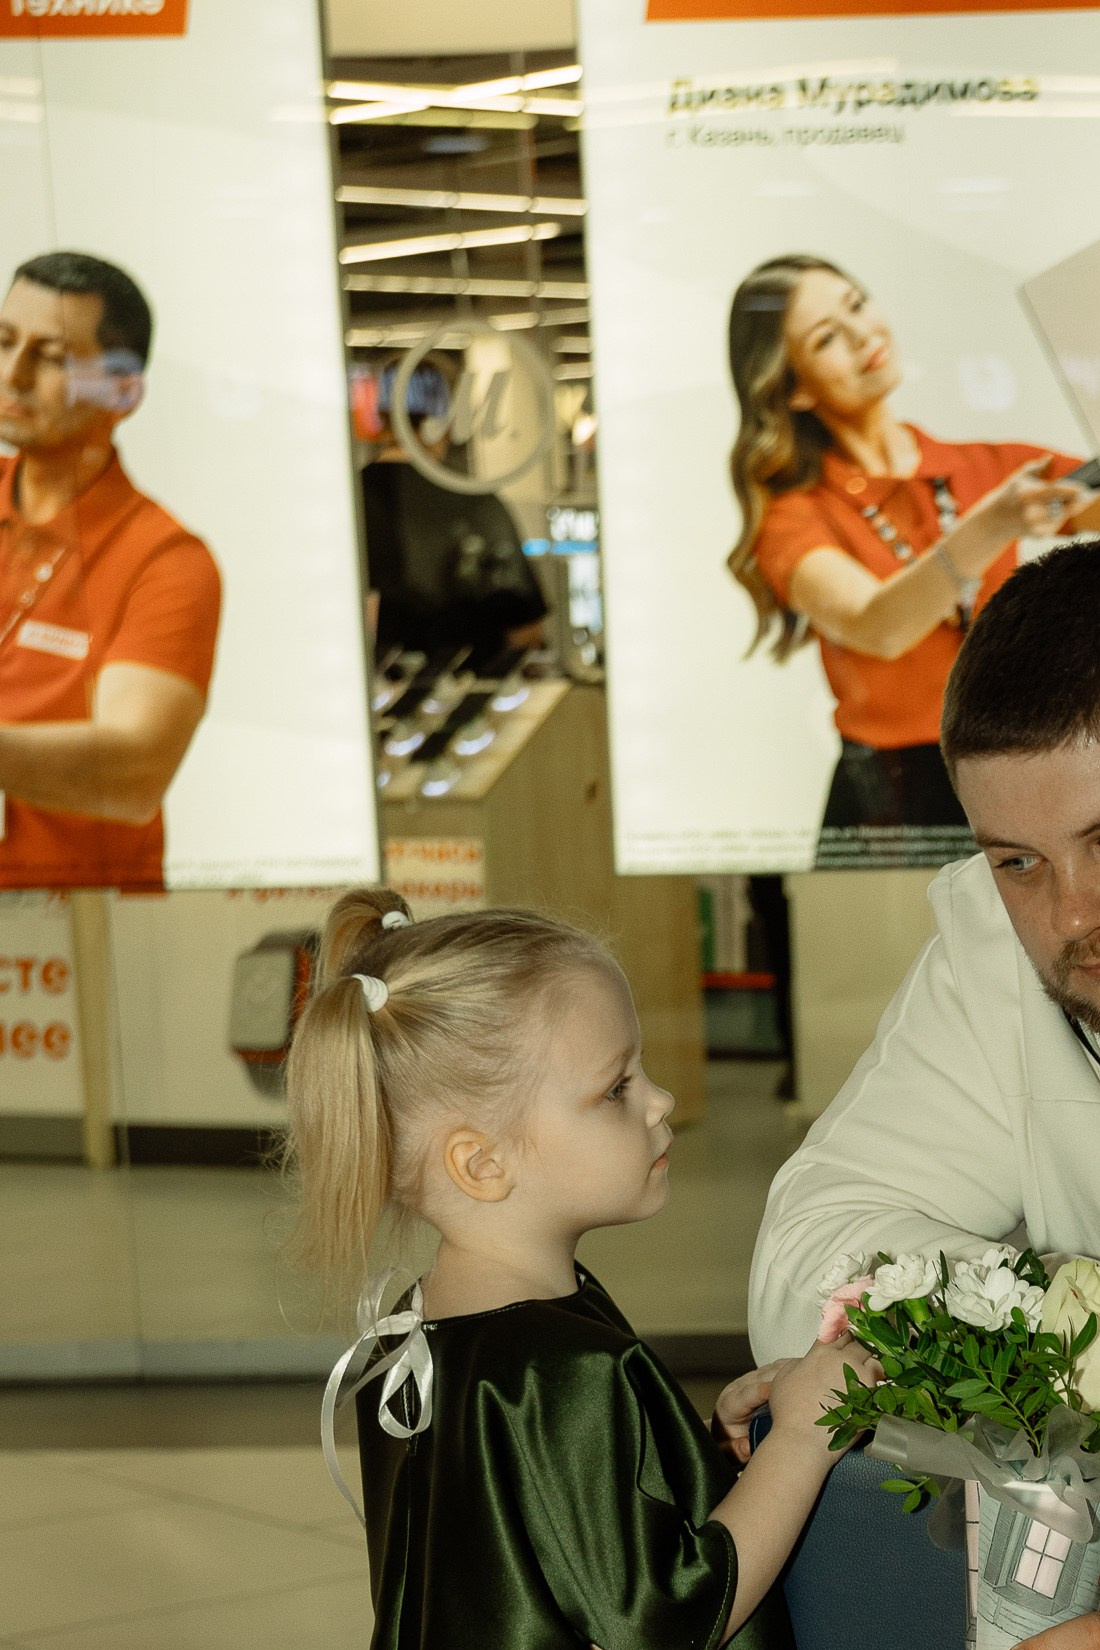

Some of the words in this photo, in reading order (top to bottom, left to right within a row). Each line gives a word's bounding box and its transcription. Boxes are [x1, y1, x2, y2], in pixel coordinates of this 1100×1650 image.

[667, 76, 785, 116] Диана
[796, 74, 1039, 116] Мурадимова
[784, 125, 906, 147] продавец
